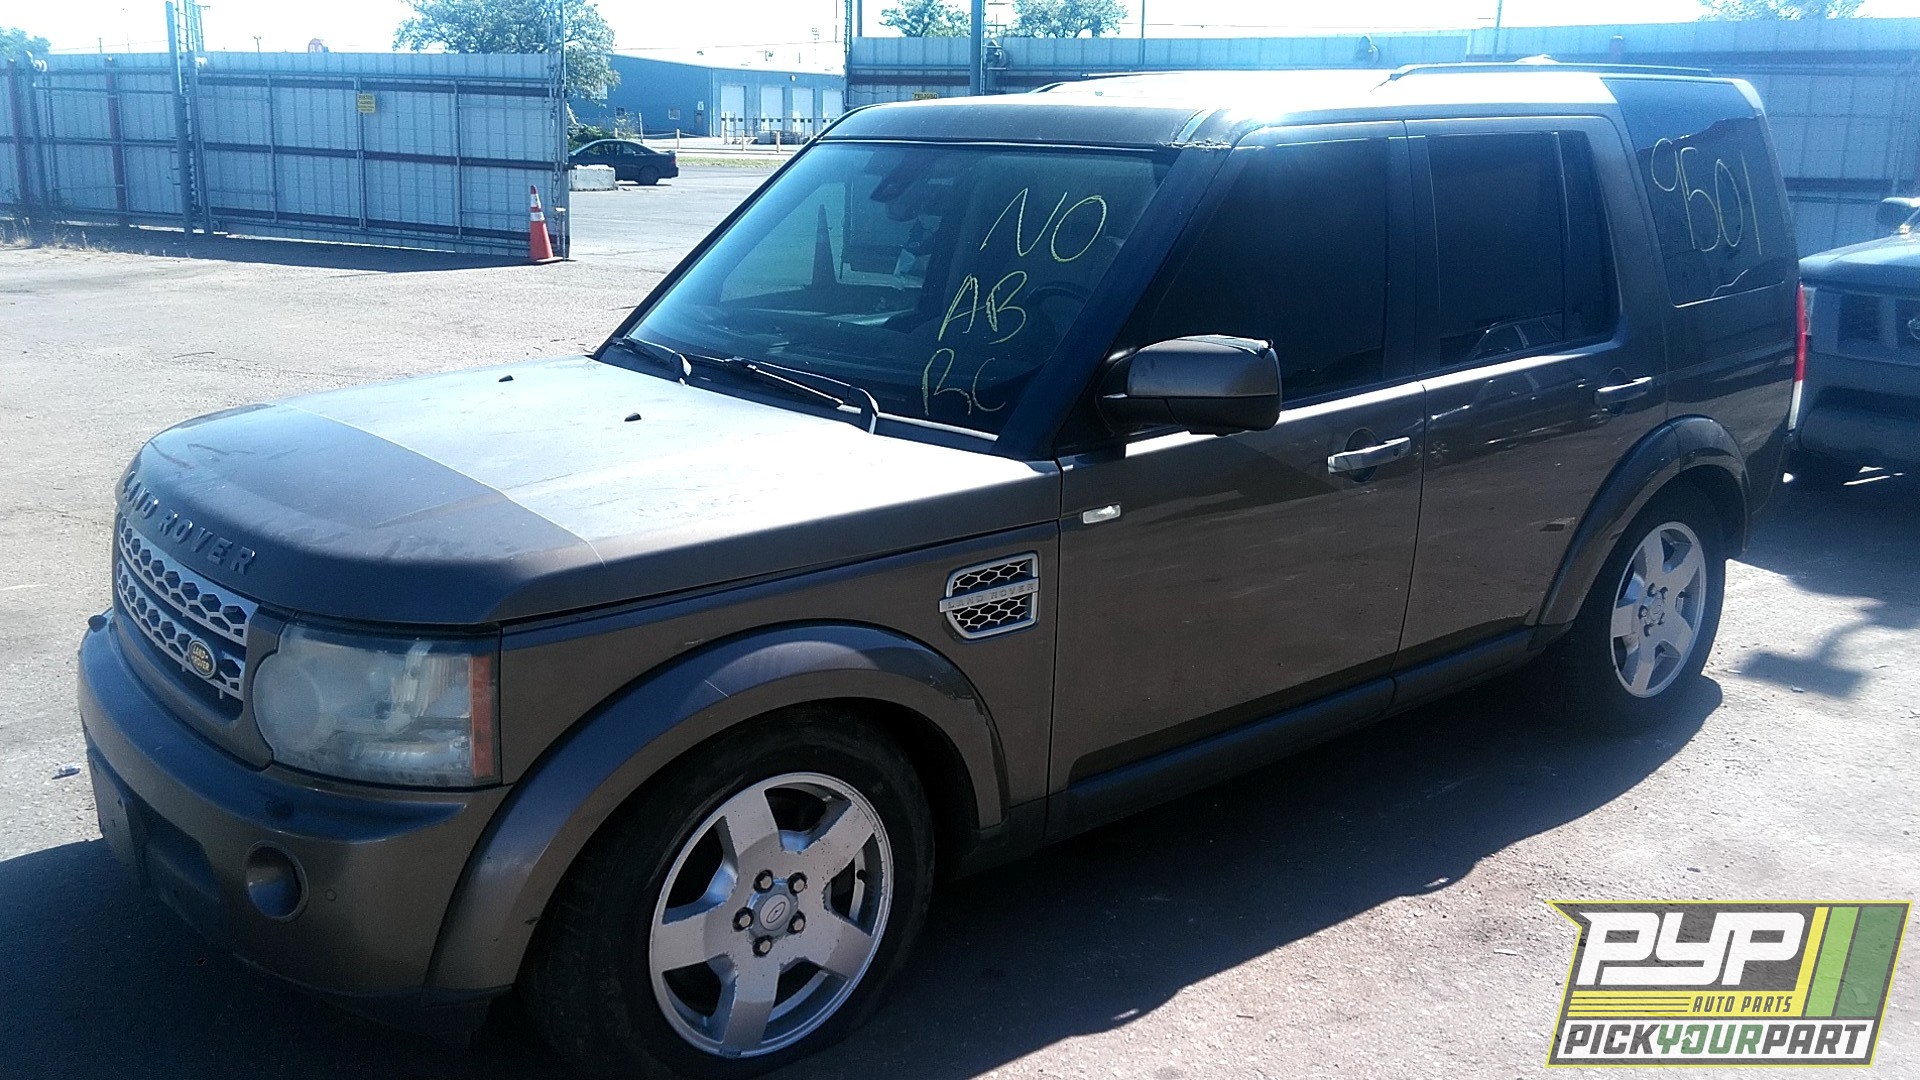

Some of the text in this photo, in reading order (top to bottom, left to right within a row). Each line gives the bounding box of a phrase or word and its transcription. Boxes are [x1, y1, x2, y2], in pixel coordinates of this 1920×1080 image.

[980, 187, 1107, 263] NO
[938, 270, 1027, 345] AB
[158, 509, 256, 576] ROVER
[947, 583, 1034, 609] LAND ROVER
